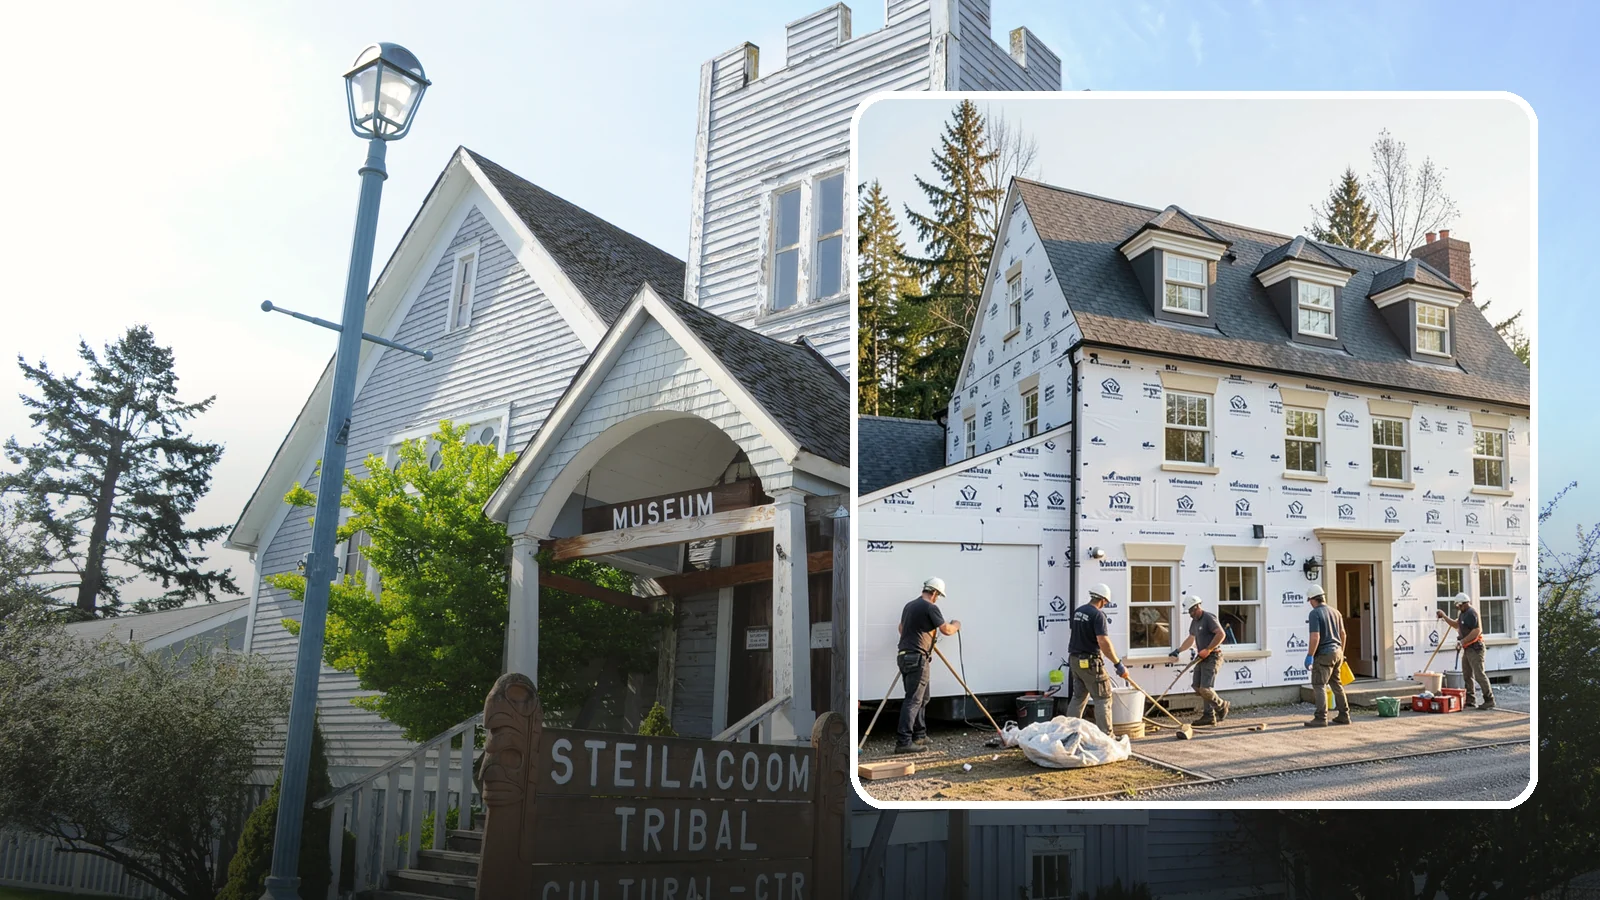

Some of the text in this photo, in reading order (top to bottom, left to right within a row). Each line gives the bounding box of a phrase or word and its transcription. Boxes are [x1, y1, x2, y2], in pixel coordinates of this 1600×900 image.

[613, 491, 713, 531] MUSEUM
[550, 738, 810, 793] STEILACOOM
[615, 806, 758, 851] TRIBAL
